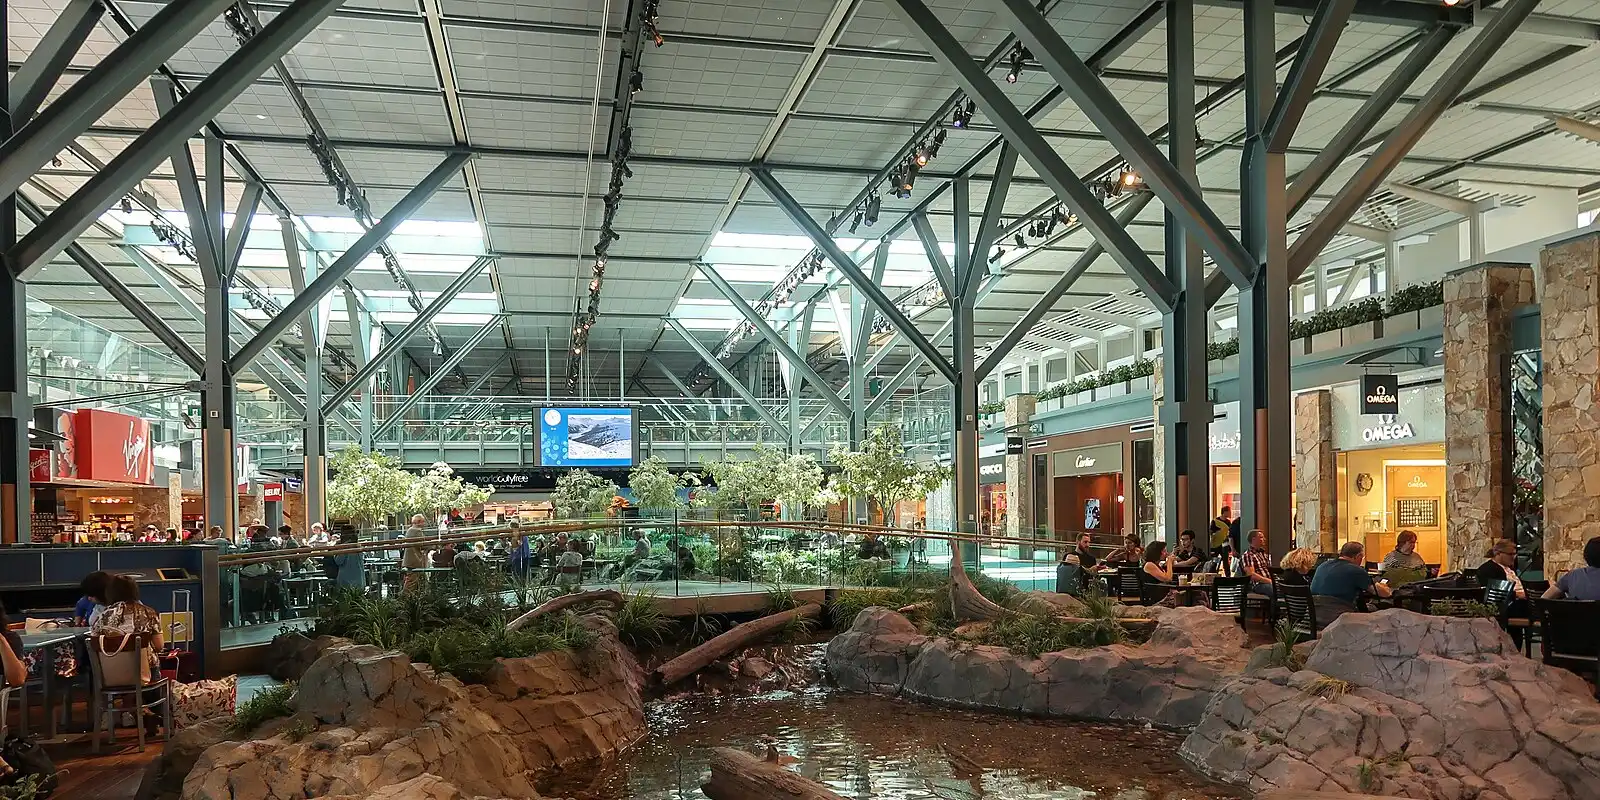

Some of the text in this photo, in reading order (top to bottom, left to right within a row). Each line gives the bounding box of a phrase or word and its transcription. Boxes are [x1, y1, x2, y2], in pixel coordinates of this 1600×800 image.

[1366, 395, 1397, 403] OMEGA
[1362, 422, 1414, 442] OMEGA
[1075, 454, 1096, 468] Cartier
